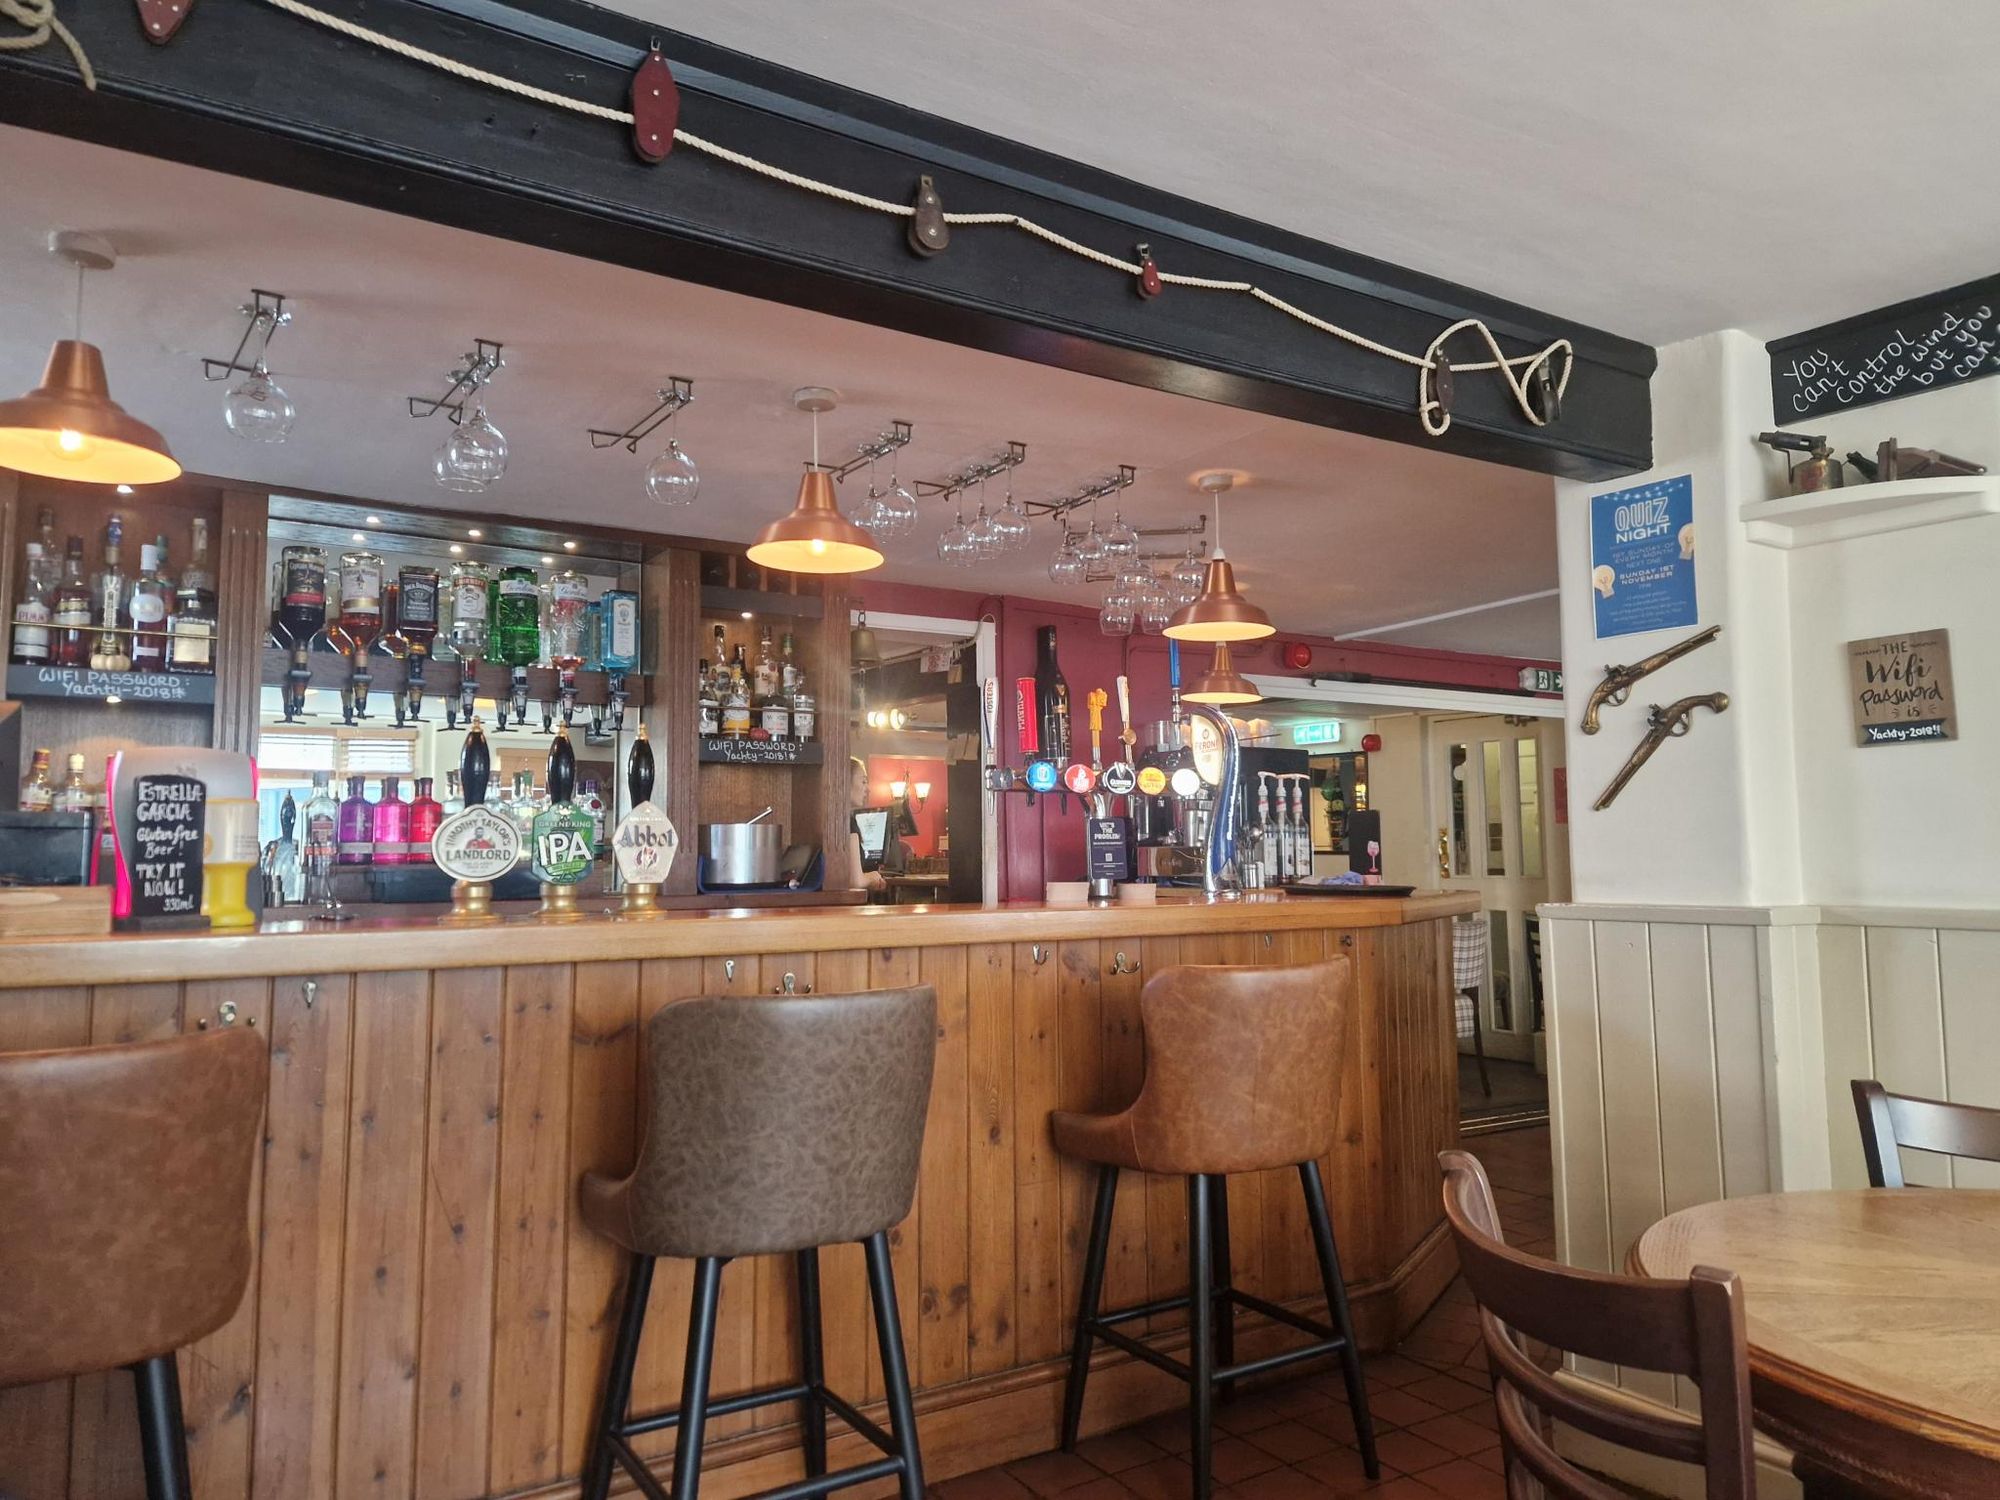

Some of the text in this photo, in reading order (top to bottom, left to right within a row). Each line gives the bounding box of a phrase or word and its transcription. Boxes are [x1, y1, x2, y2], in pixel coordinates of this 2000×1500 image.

[1874, 364, 1910, 394] the
[1912, 312, 1964, 361] wind
[1912, 349, 1954, 385] but
[1955, 305, 1993, 347] you
[1784, 349, 1828, 386] You
[1836, 329, 1915, 402] control
[1954, 340, 1995, 377] can
[1793, 360, 1849, 412] can't
[1616, 522, 1672, 544] NIGHT
[1619, 564, 1675, 580] SUNDAY 1ST
[1621, 571, 1674, 585] NOVEMBER
[1881, 641, 1908, 655] THE
[39, 668, 79, 682] WIFI
[1907, 705, 1921, 717] is
[709, 740, 733, 751] WIFI
[136, 802, 194, 822] GARCIA
[445, 819, 479, 846] TIMOTHY
[571, 820, 591, 828] KING
[617, 824, 674, 848] Abbot
[446, 849, 511, 861] LANDLORD
[538, 831, 593, 866] IPA
[136, 862, 185, 880] TRY IT
